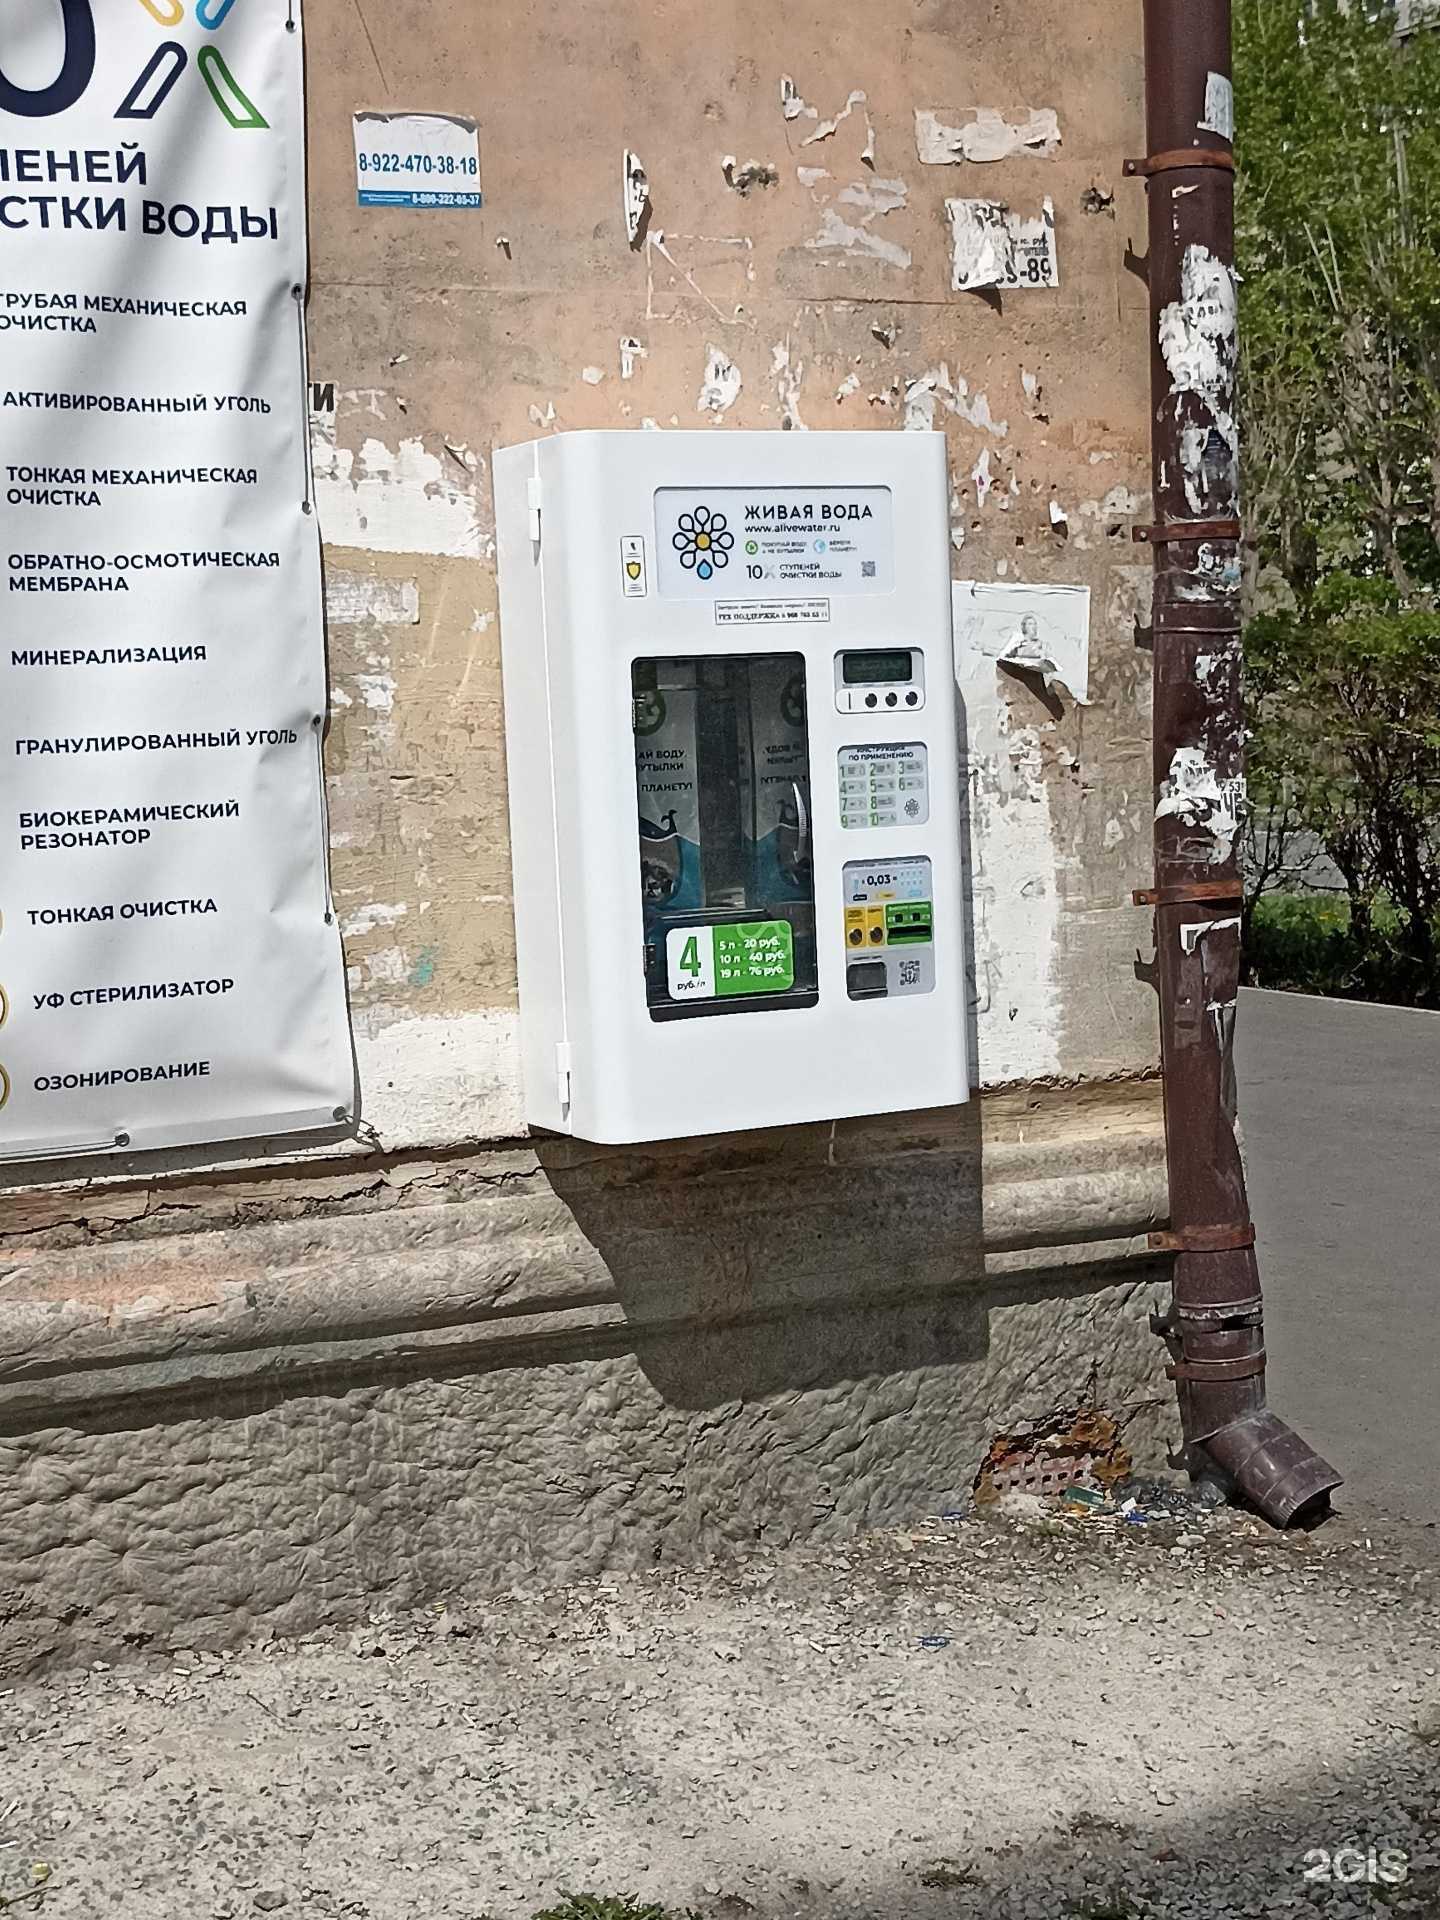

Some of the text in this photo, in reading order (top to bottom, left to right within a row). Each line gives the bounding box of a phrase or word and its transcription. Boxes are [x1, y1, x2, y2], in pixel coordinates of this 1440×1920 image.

[359, 153, 477, 175] 8-922-470-38-18
[142, 200, 278, 244] ВОДЫ
[84, 296, 247, 317] МЕХАНИЧЕСКАЯ
[3, 391, 271, 413] АКТИВИРОВАННЫЙ УГОЛЬ
[6, 466, 257, 485] ТОНКАЯ МЕХАНИЧЕСКАЯ
[6, 488, 101, 506] ОЧИСТКА
[744, 503, 873, 520] ЖИВАЯ ВОДА
[744, 523, 841, 533] www.alivewater.ru
[8, 552, 280, 570] ОБРАТНО-ОСМОТИЧЕСКАЯ
[780, 563, 820, 571] СТУПЕНЕЙ
[780, 571, 843, 579] ОЧИСТКИ ВОДЫ
[9, 576, 129, 592] МЕМБРАНА
[11, 646, 207, 666] МИНЕРАЛИЗАЦИЯ
[15, 728, 297, 755] ГРАНУЛИРОВАННЫЙ УГОЛЬ
[861, 752, 913, 760] ПРИМЕНЕНИЮ
[870, 763, 876, 776] 2
[898, 761, 904, 775] 3
[870, 779, 877, 793] 5
[899, 777, 905, 791] 6
[841, 798, 848, 811] 7
[871, 796, 877, 809] 8
[19, 800, 240, 828] БИОКЕРАМИЧЕСКИЙ
[20, 829, 151, 850] РЕЗОНАТОР
[866, 874, 891, 886] 0,03
[27, 898, 218, 925] ТОНКАЯ ОЧИСТКА
[719, 940, 727, 950] 5
[744, 938, 757, 948] 20
[759, 936, 780, 949] руб.
[679, 936, 701, 977] 4
[720, 954, 732, 964] 10
[749, 952, 763, 962] 40
[765, 950, 787, 963] руб.
[720, 969, 732, 979] 19
[749, 966, 762, 976] 76
[764, 964, 785, 977] руб.
[33, 978, 235, 1010] УФ СТЕРИЛИЗАТОР
[33, 1061, 211, 1091] ОЗОНИРОВАНИЕ
